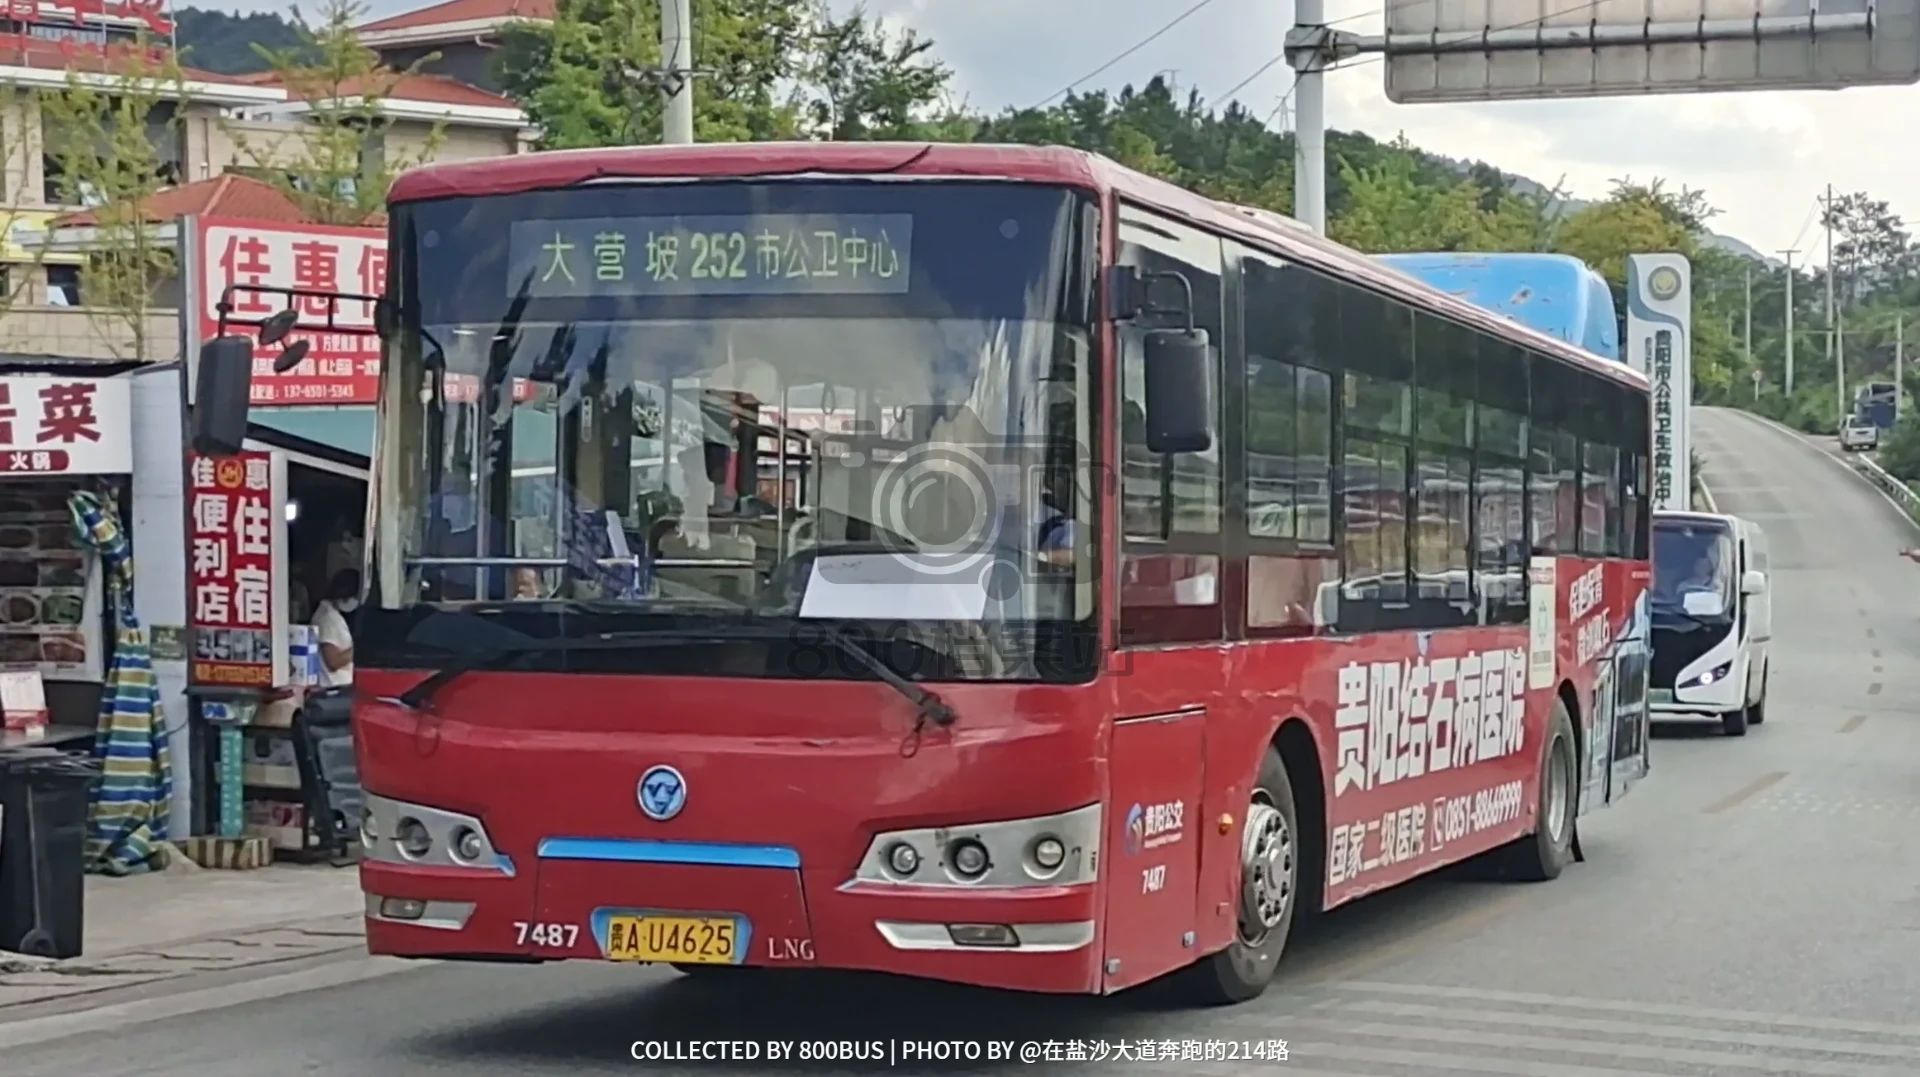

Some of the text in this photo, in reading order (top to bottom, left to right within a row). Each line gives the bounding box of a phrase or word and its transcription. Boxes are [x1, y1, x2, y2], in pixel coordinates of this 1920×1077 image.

[542, 228, 899, 285] 大营坡 252 市公卫中心
[9, 451, 51, 470] 火锅
[193, 493, 230, 623] 便利店
[233, 495, 269, 625] 住宿
[1334, 646, 1526, 798] 贵阳结石病医院
[1144, 799, 1184, 837] 贵阳公交
[1329, 802, 1427, 887] 国家二级医院
[1142, 865, 1167, 894] 7487
[513, 922, 580, 949] 7487
[769, 937, 816, 960] LNG
